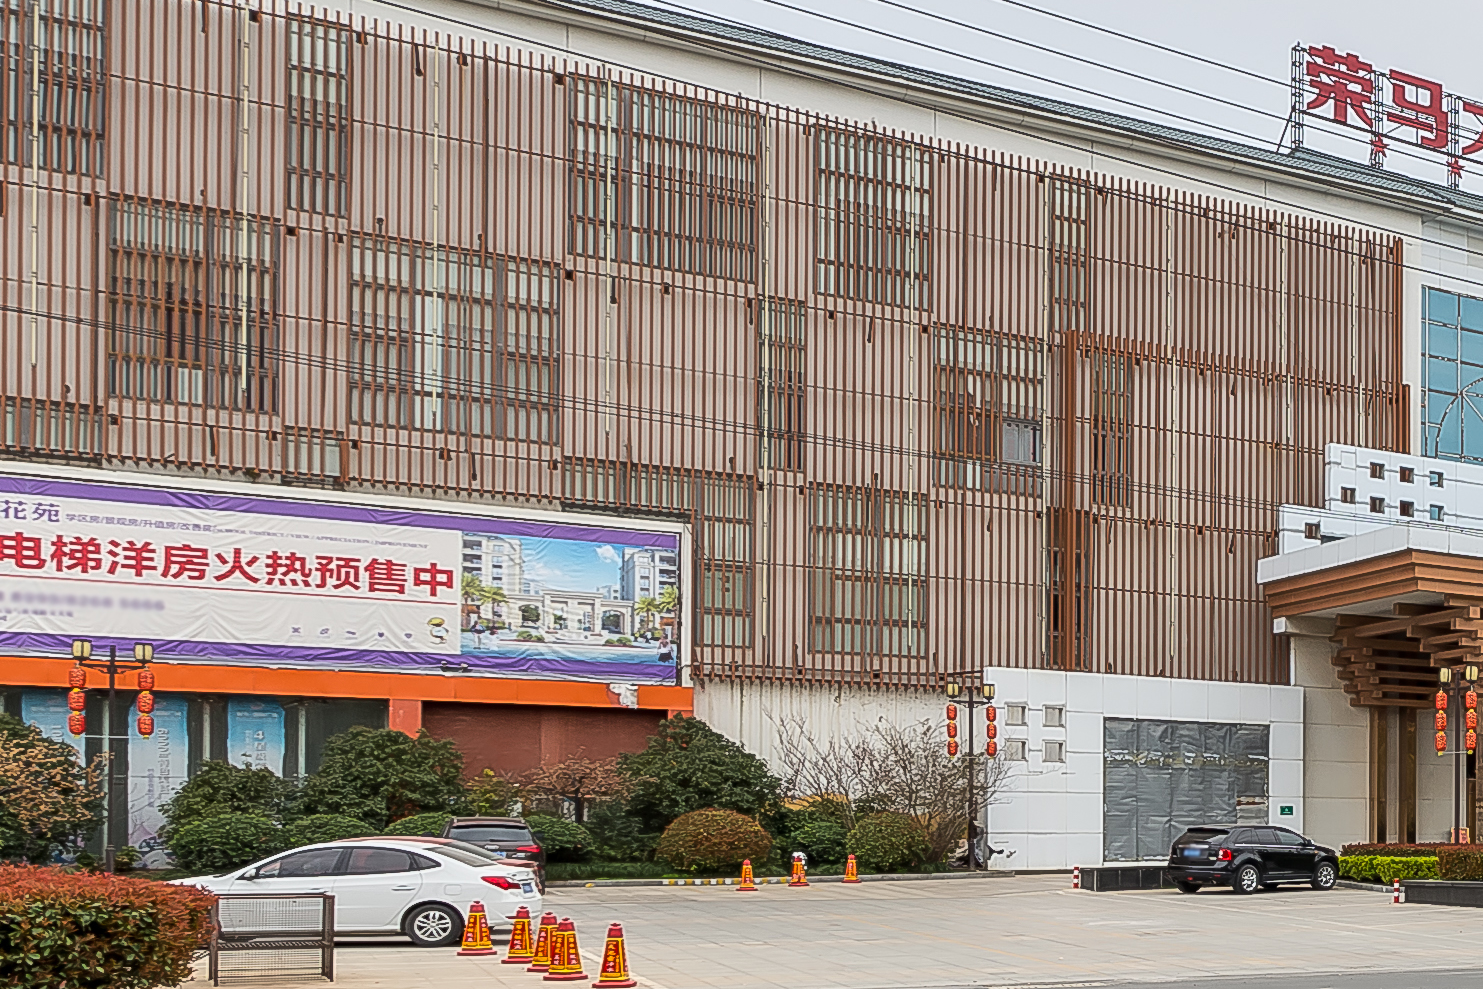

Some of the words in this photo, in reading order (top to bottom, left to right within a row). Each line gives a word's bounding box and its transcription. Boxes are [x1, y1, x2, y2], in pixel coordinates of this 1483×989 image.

[0, 499, 61, 523] 花苑
[0, 531, 454, 597] 电梯洋房火热预售中
